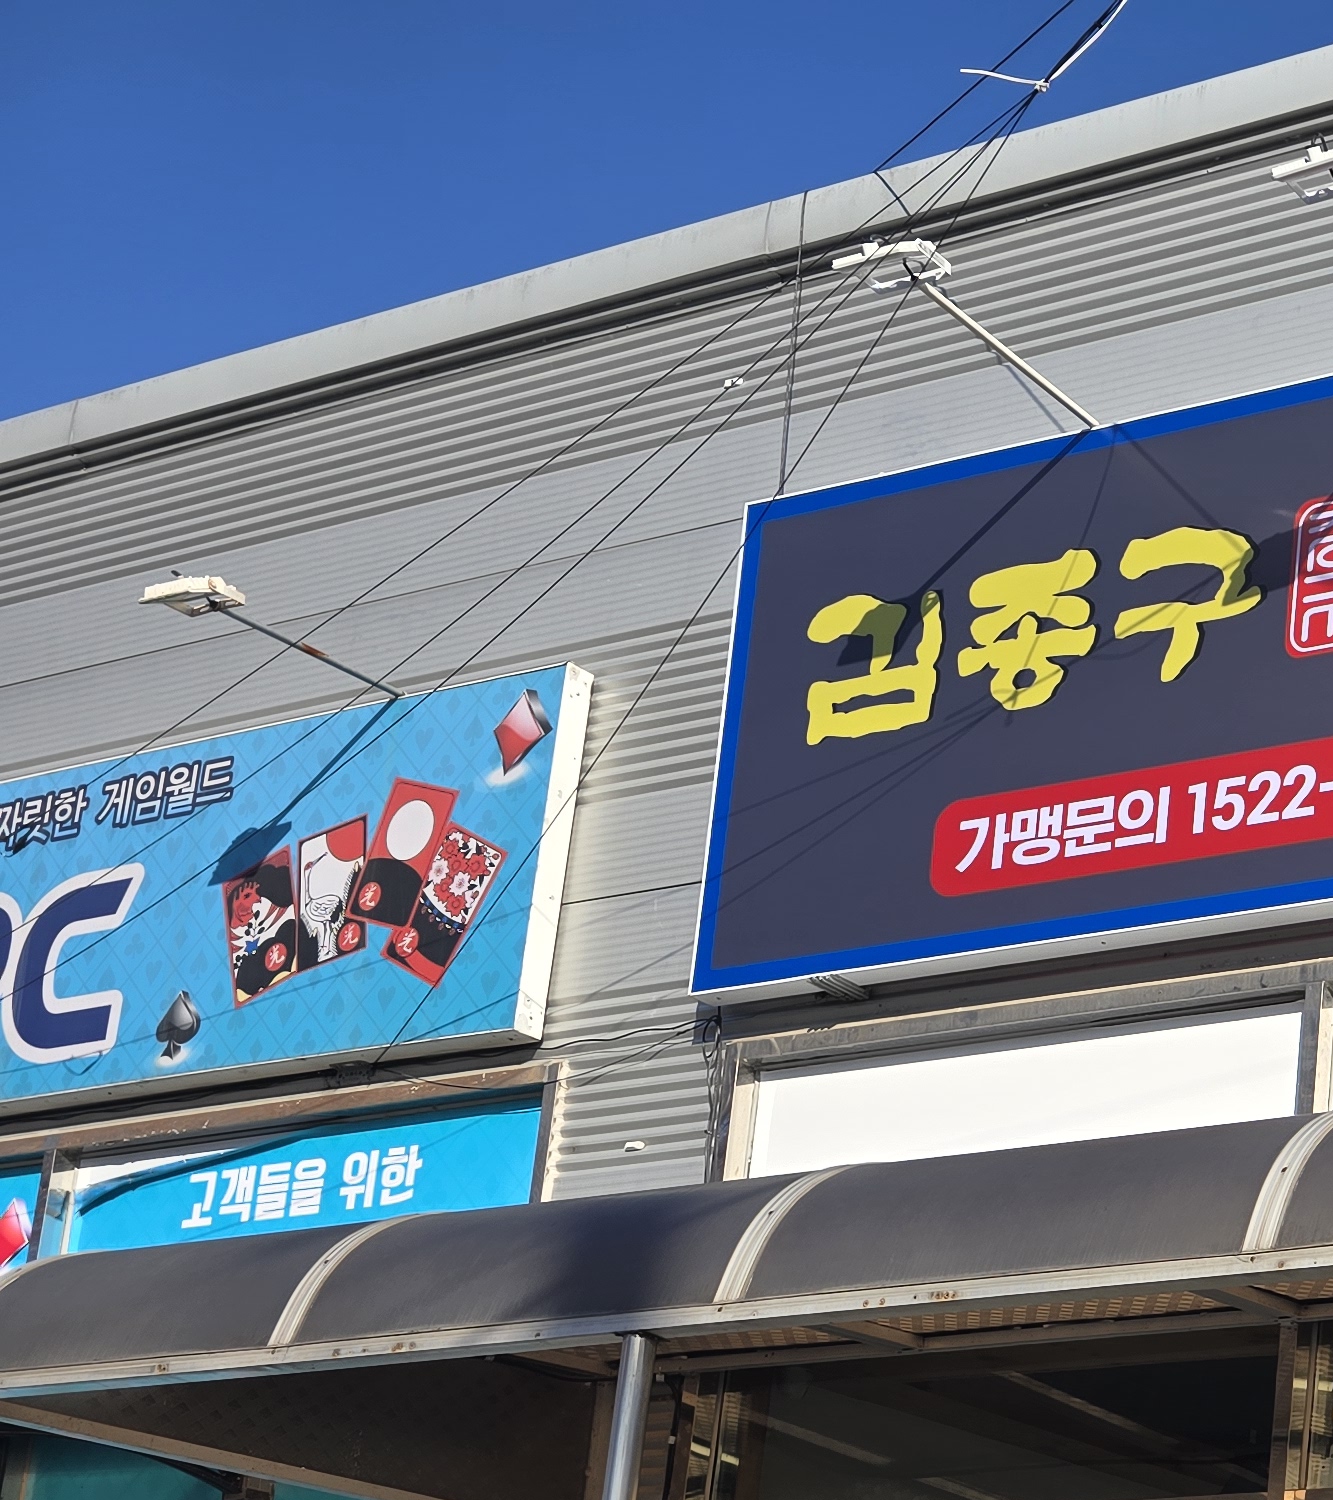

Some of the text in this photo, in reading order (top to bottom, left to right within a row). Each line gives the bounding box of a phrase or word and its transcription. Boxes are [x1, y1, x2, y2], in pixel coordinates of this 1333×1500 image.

[807, 526, 1265, 745] 김종구
[96, 757, 235, 828] 게임월드
[953, 785, 1170, 872] 가맹문의
[181, 1145, 423, 1230] 고객들을 위한
